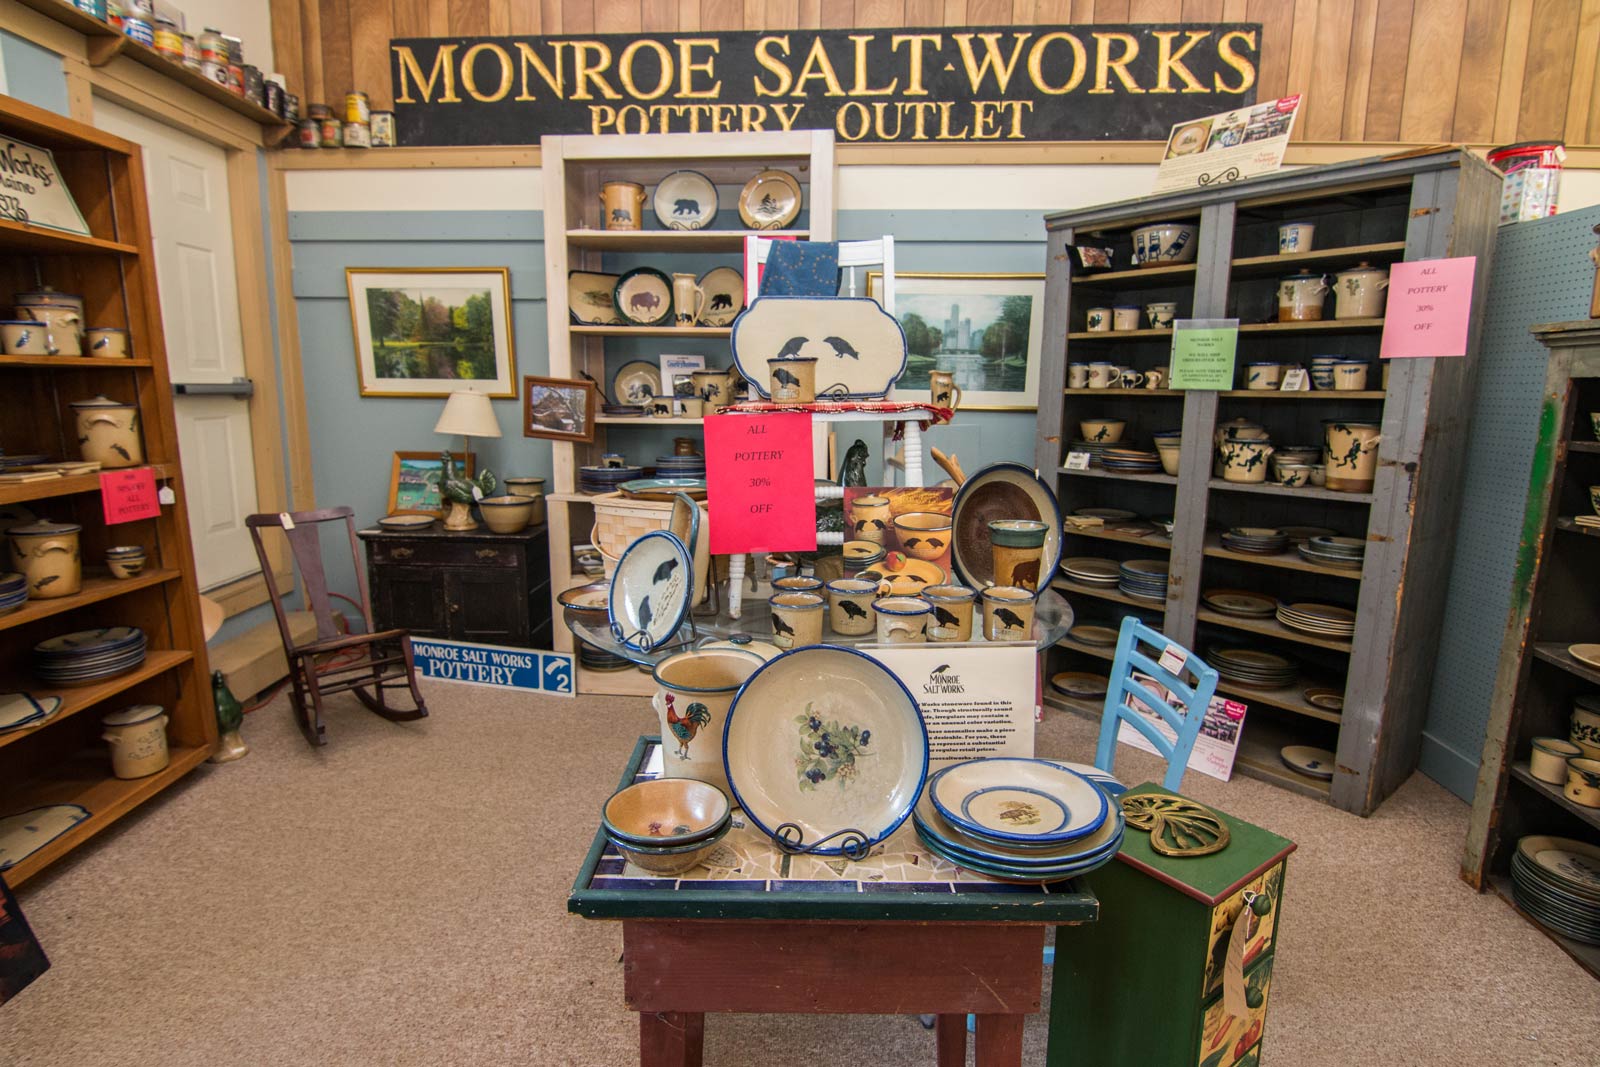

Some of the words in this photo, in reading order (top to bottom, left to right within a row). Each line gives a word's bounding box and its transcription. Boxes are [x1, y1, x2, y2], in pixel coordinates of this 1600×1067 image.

[391, 38, 722, 103] MONROE
[753, 34, 942, 98] SALT
[951, 30, 1257, 96] WORKS
[588, 103, 805, 135] POTTERY
[836, 100, 1034, 141] OUTLET
[1420, 267, 1437, 276] ALL
[1407, 285, 1448, 295] POTTERY
[1415, 304, 1434, 313] 30%
[1413, 322, 1433, 331] OFF
[747, 424, 767, 435] ALL
[734, 450, 784, 461] POTTERY
[749, 478, 771, 487] 30%
[750, 503, 774, 514] OFF
[413, 643, 459, 661] MONROE
[462, 649, 488, 664] SALT
[491, 652, 532, 669] WORKS
[428, 658, 517, 686] POTTERY
[556, 673, 570, 692] 2
[929, 673, 961, 685] MONROE
